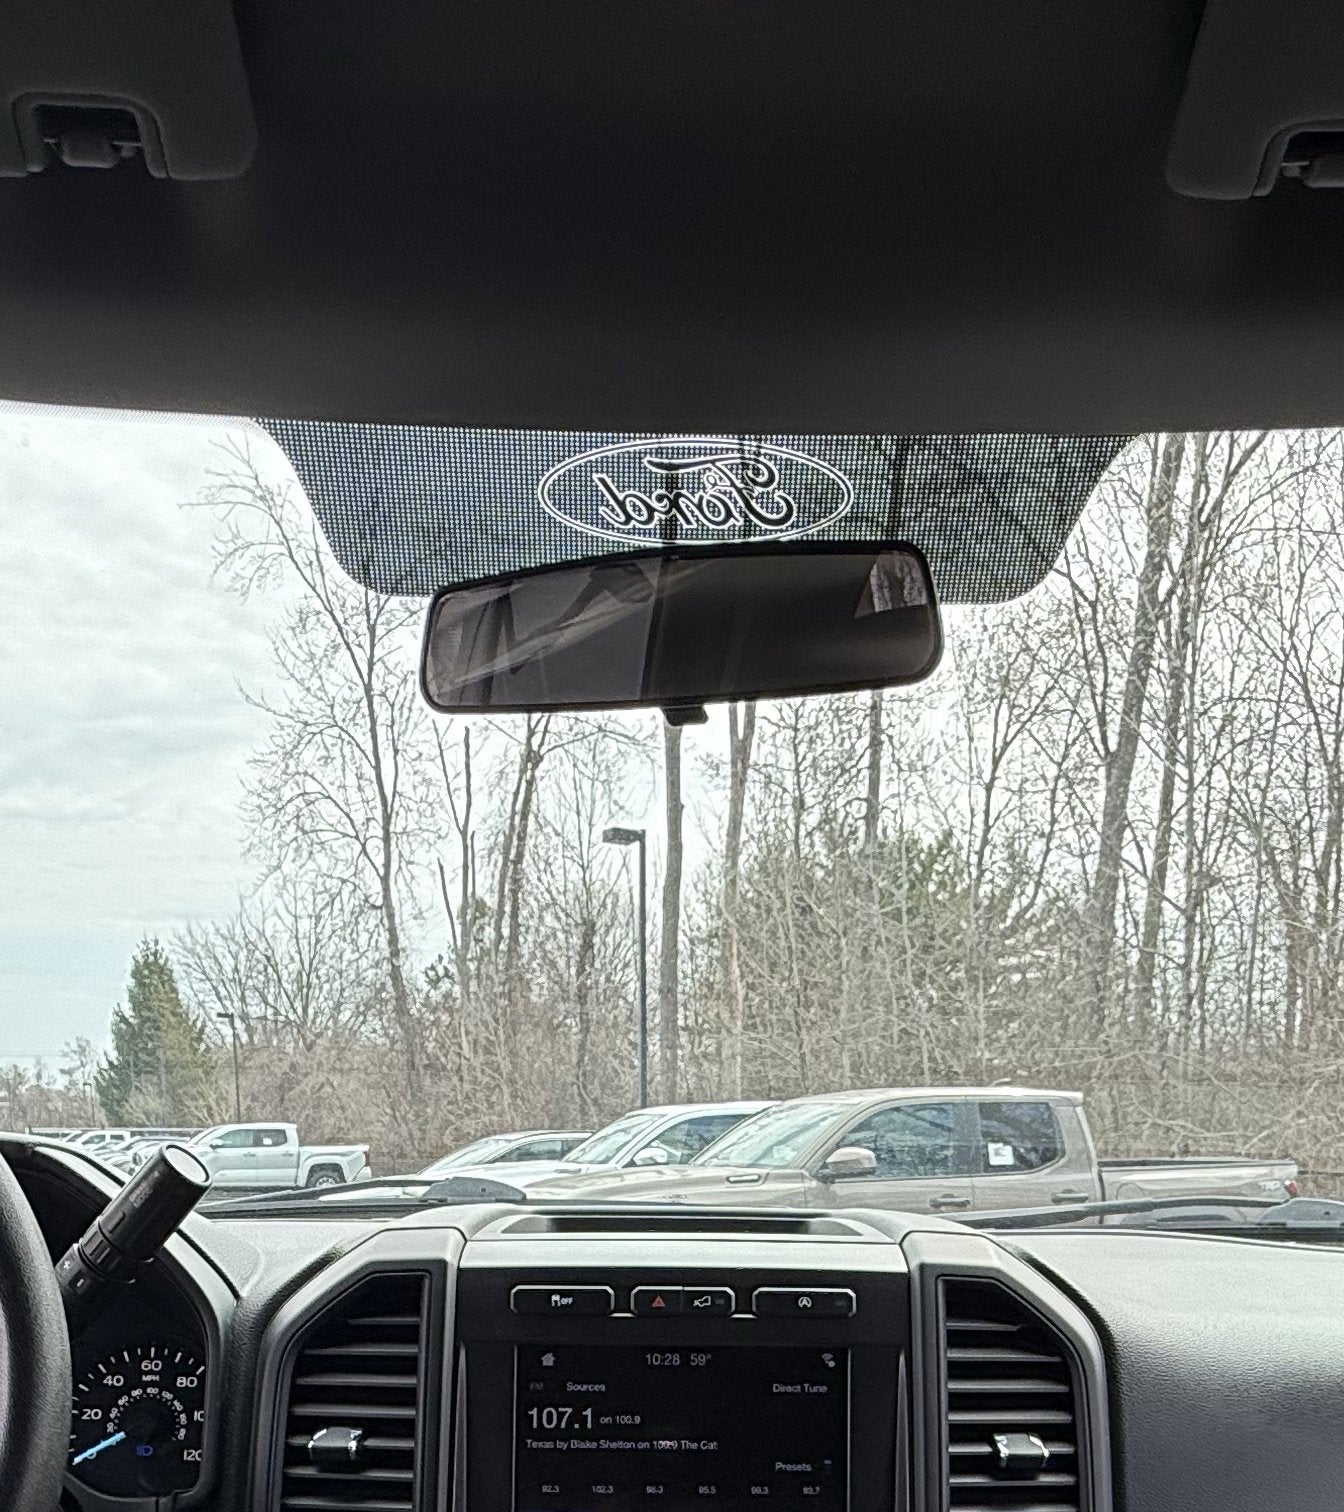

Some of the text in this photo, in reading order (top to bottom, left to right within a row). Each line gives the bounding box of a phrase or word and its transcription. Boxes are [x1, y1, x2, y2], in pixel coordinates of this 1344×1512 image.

[141, 1360, 162, 1371] 60
[645, 1354, 680, 1366] 10:28
[103, 1375, 124, 1386] 40
[176, 1377, 197, 1387] 80
[566, 1382, 606, 1392] Sources
[772, 1383, 828, 1393] Direct Tune
[81, 1409, 102, 1420] 20
[527, 1407, 593, 1429] 107.1
[600, 1416, 613, 1424] on
[526, 1440, 555, 1449] Texas
[556, 1440, 569, 1451] by
[599, 1439, 636, 1449] Shelton
[681, 1440, 698, 1450] The
[775, 1462, 812, 1472] Presets
